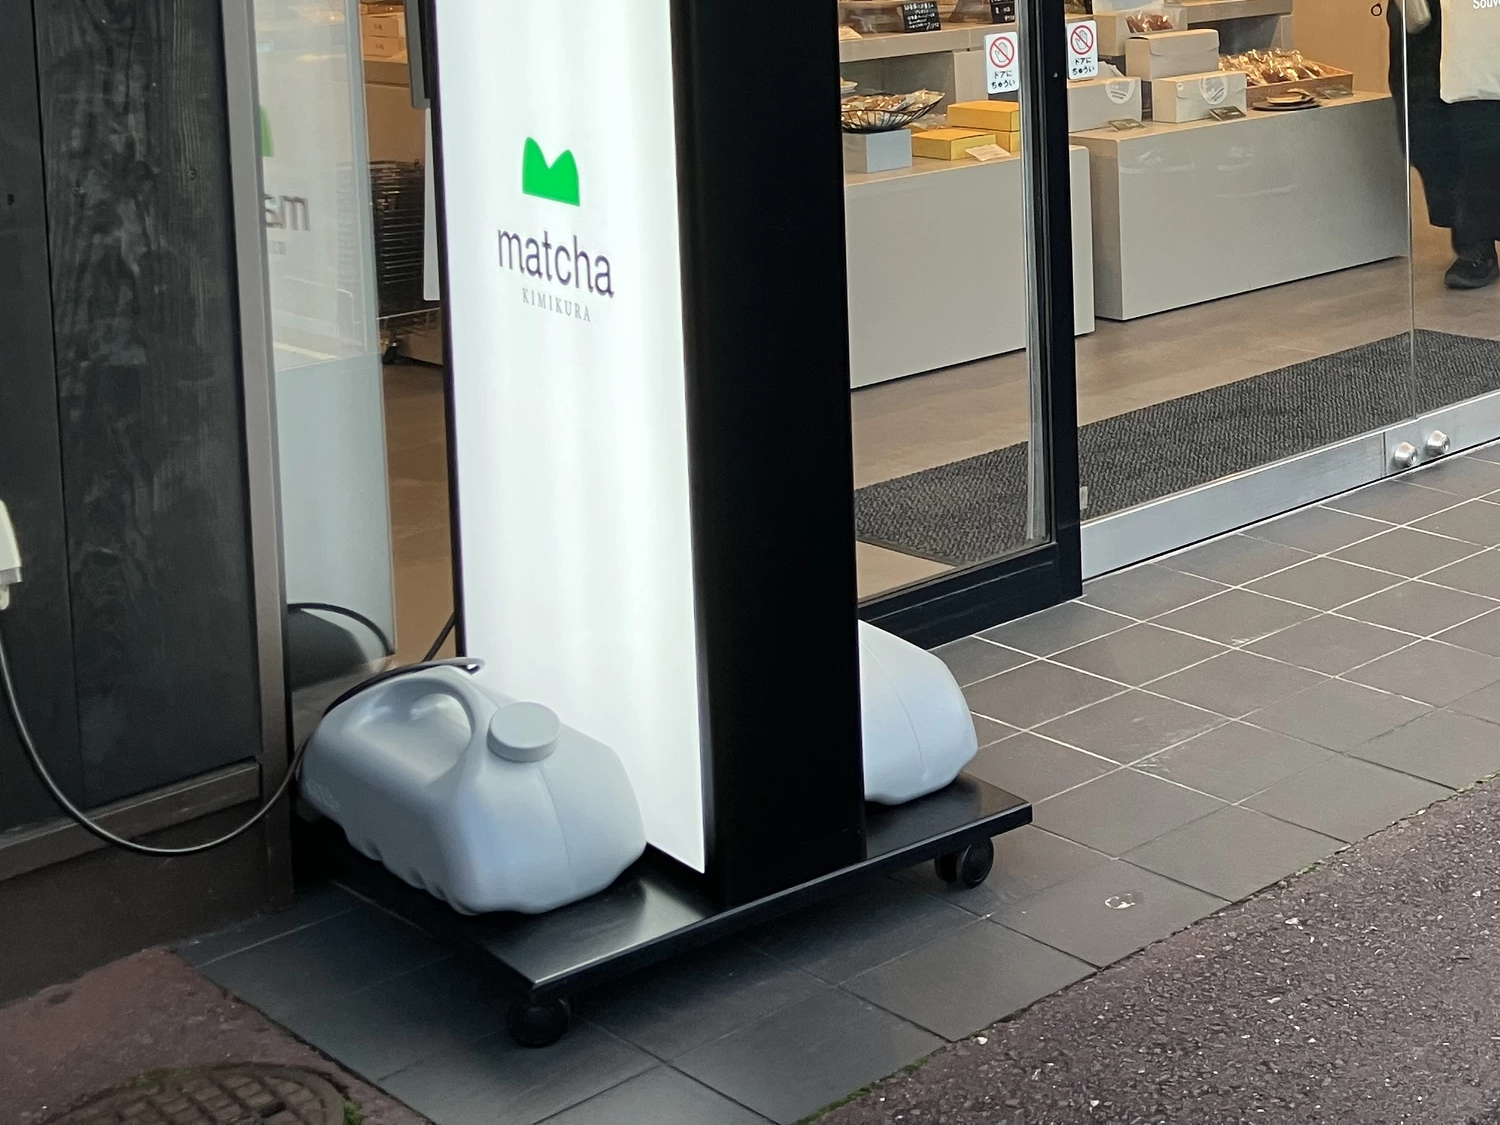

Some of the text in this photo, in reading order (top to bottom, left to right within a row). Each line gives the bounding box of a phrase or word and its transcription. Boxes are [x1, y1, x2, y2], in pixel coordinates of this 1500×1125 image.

[1074, 56, 1092, 65] ドアに
[994, 70, 1012, 79] ドアに
[1072, 65, 1096, 76] ちゅうい
[991, 79, 1016, 89] ちゅうい
[498, 229, 615, 299] matcha
[522, 287, 591, 322] KIMIKURA
